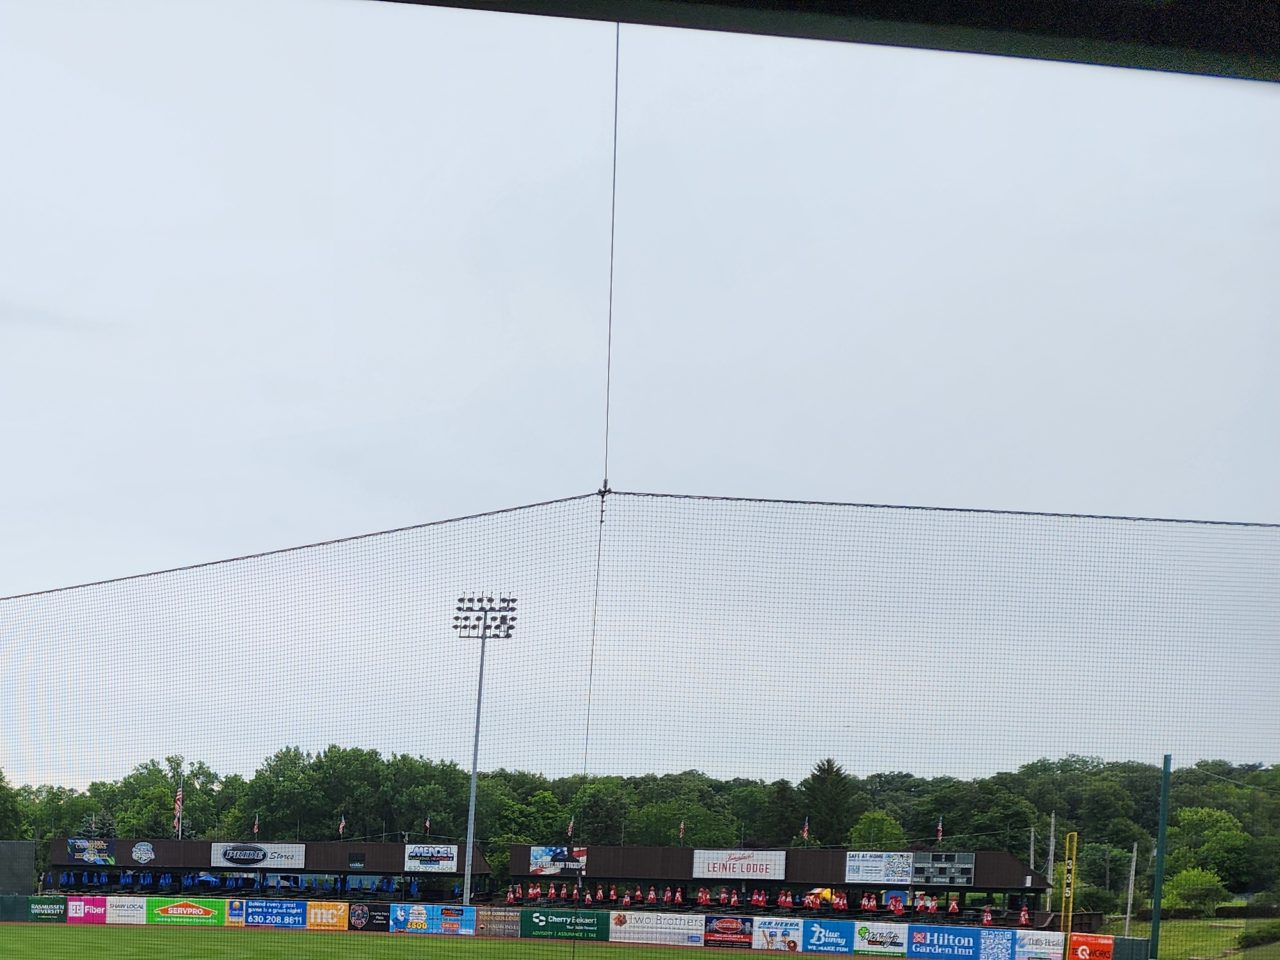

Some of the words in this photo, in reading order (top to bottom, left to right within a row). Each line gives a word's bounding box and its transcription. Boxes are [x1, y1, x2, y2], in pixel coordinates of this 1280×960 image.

[225, 850, 265, 860] PRIDE
[268, 851, 295, 860] Stores
[408, 845, 454, 857] MENDEL
[707, 862, 737, 873] LEINIE
[740, 863, 771, 874] LODGE
[84, 905, 105, 914] Fiber
[547, 915, 571, 925] Cherry
[628, 913, 652, 925] Two
[656, 914, 704, 927] Brothers
[926, 932, 974, 947] Hilton
[912, 944, 953, 955] Garden
[954, 946, 975, 956] Inn
